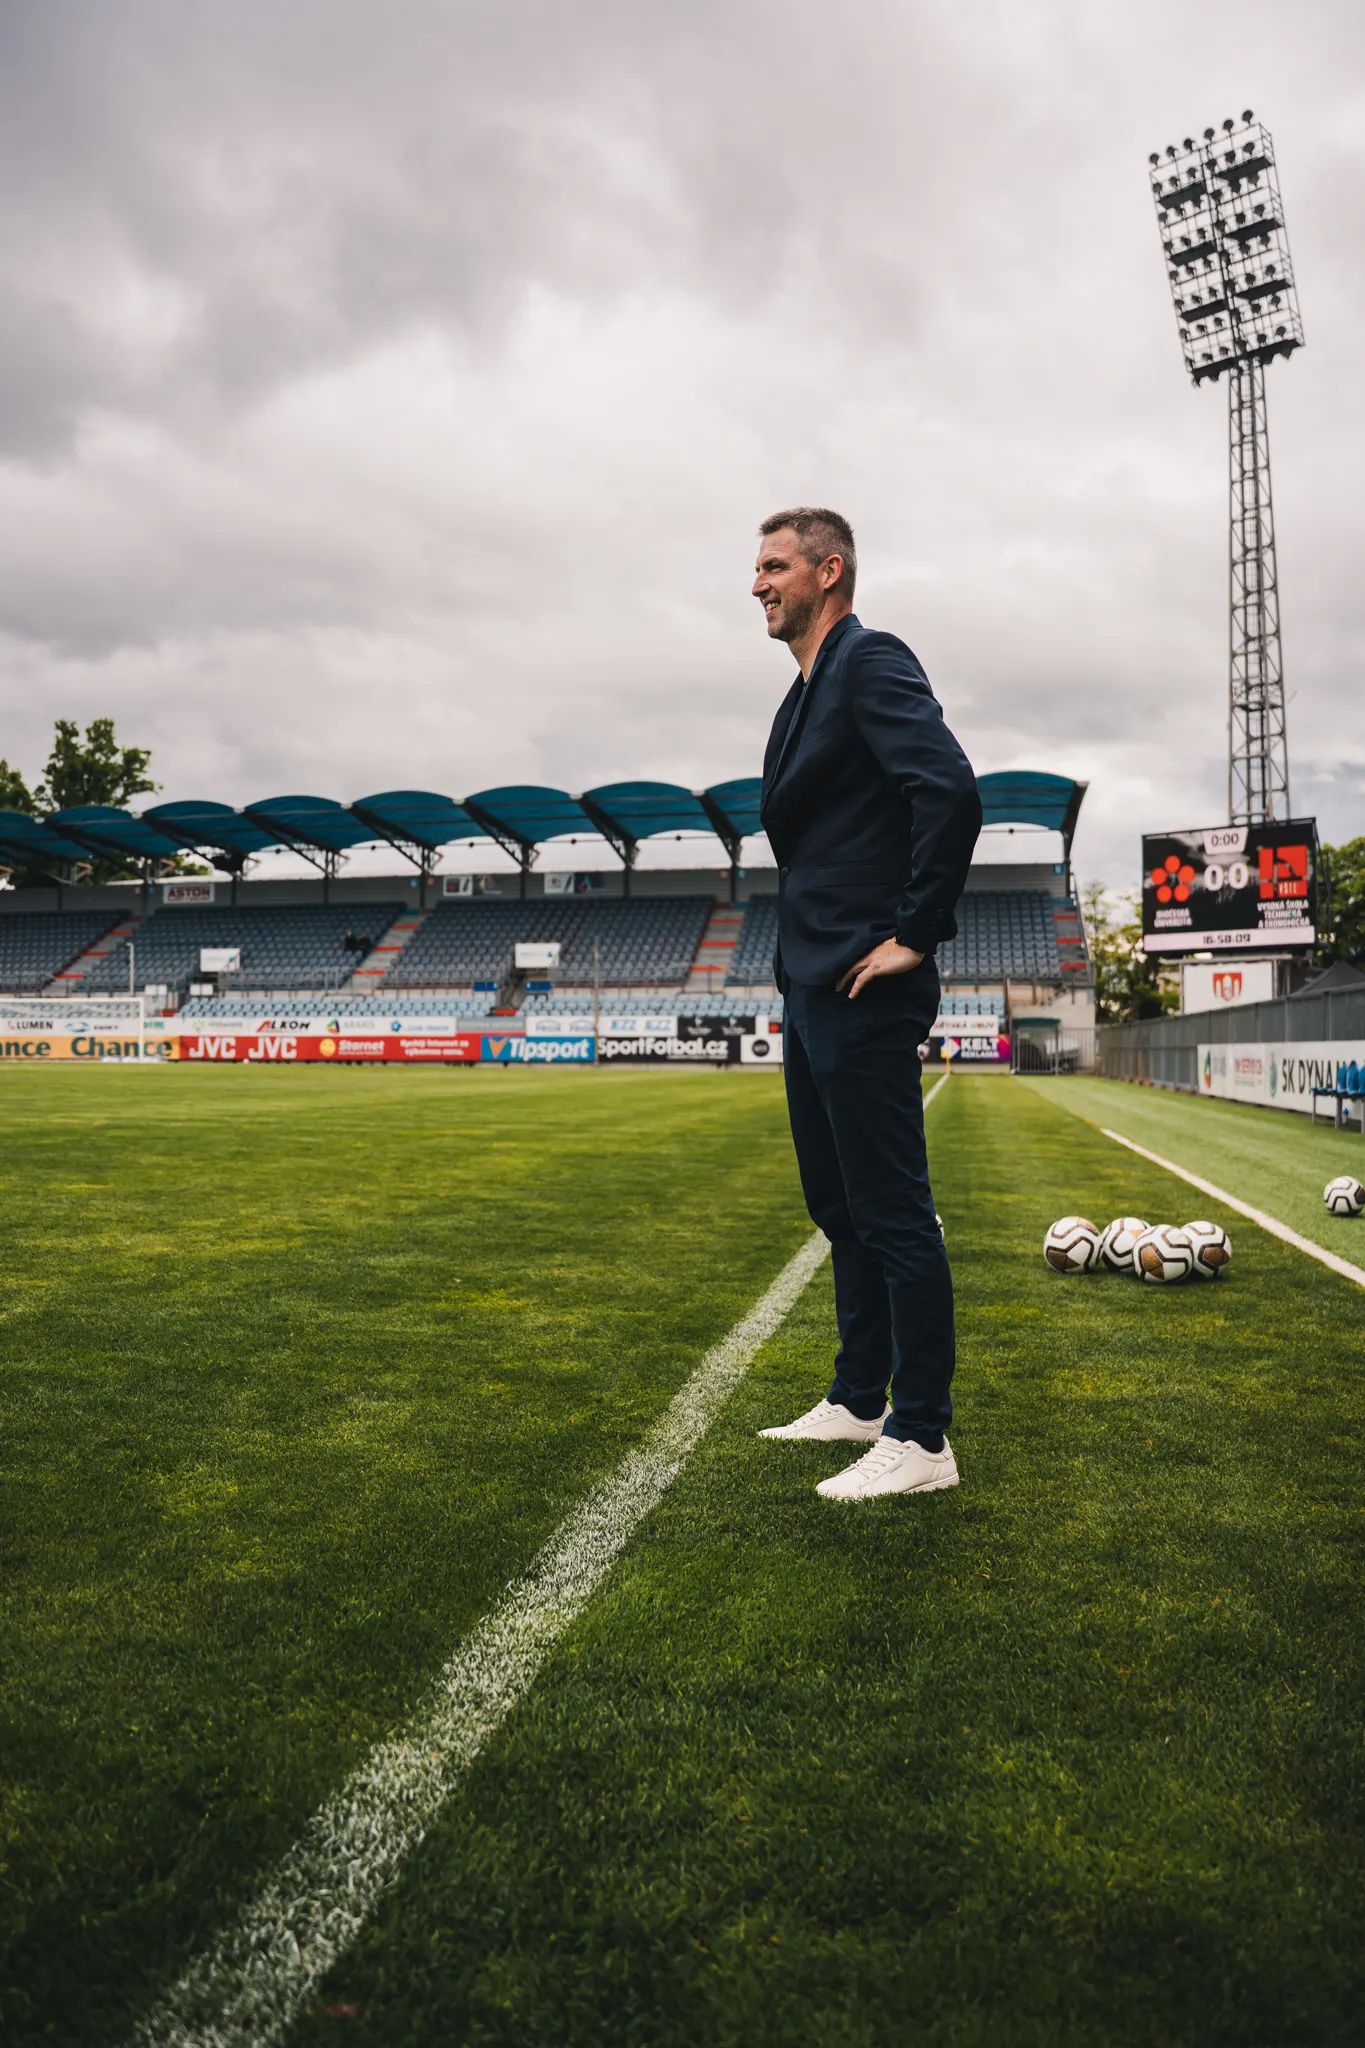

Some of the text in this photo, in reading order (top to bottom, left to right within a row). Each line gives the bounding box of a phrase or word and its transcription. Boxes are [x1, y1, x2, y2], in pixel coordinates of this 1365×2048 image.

[1211, 833, 1239, 847] 0:00
[1203, 862, 1249, 891] 0:0
[17, 1021, 53, 1029] LUMEN
[0, 1036, 172, 1056] nce Chance
[189, 1036, 296, 1058] JVC JVC
[509, 1038, 589, 1061] Tipsport
[961, 1038, 998, 1050] KELT
[1282, 1059, 1295, 1093] SK
